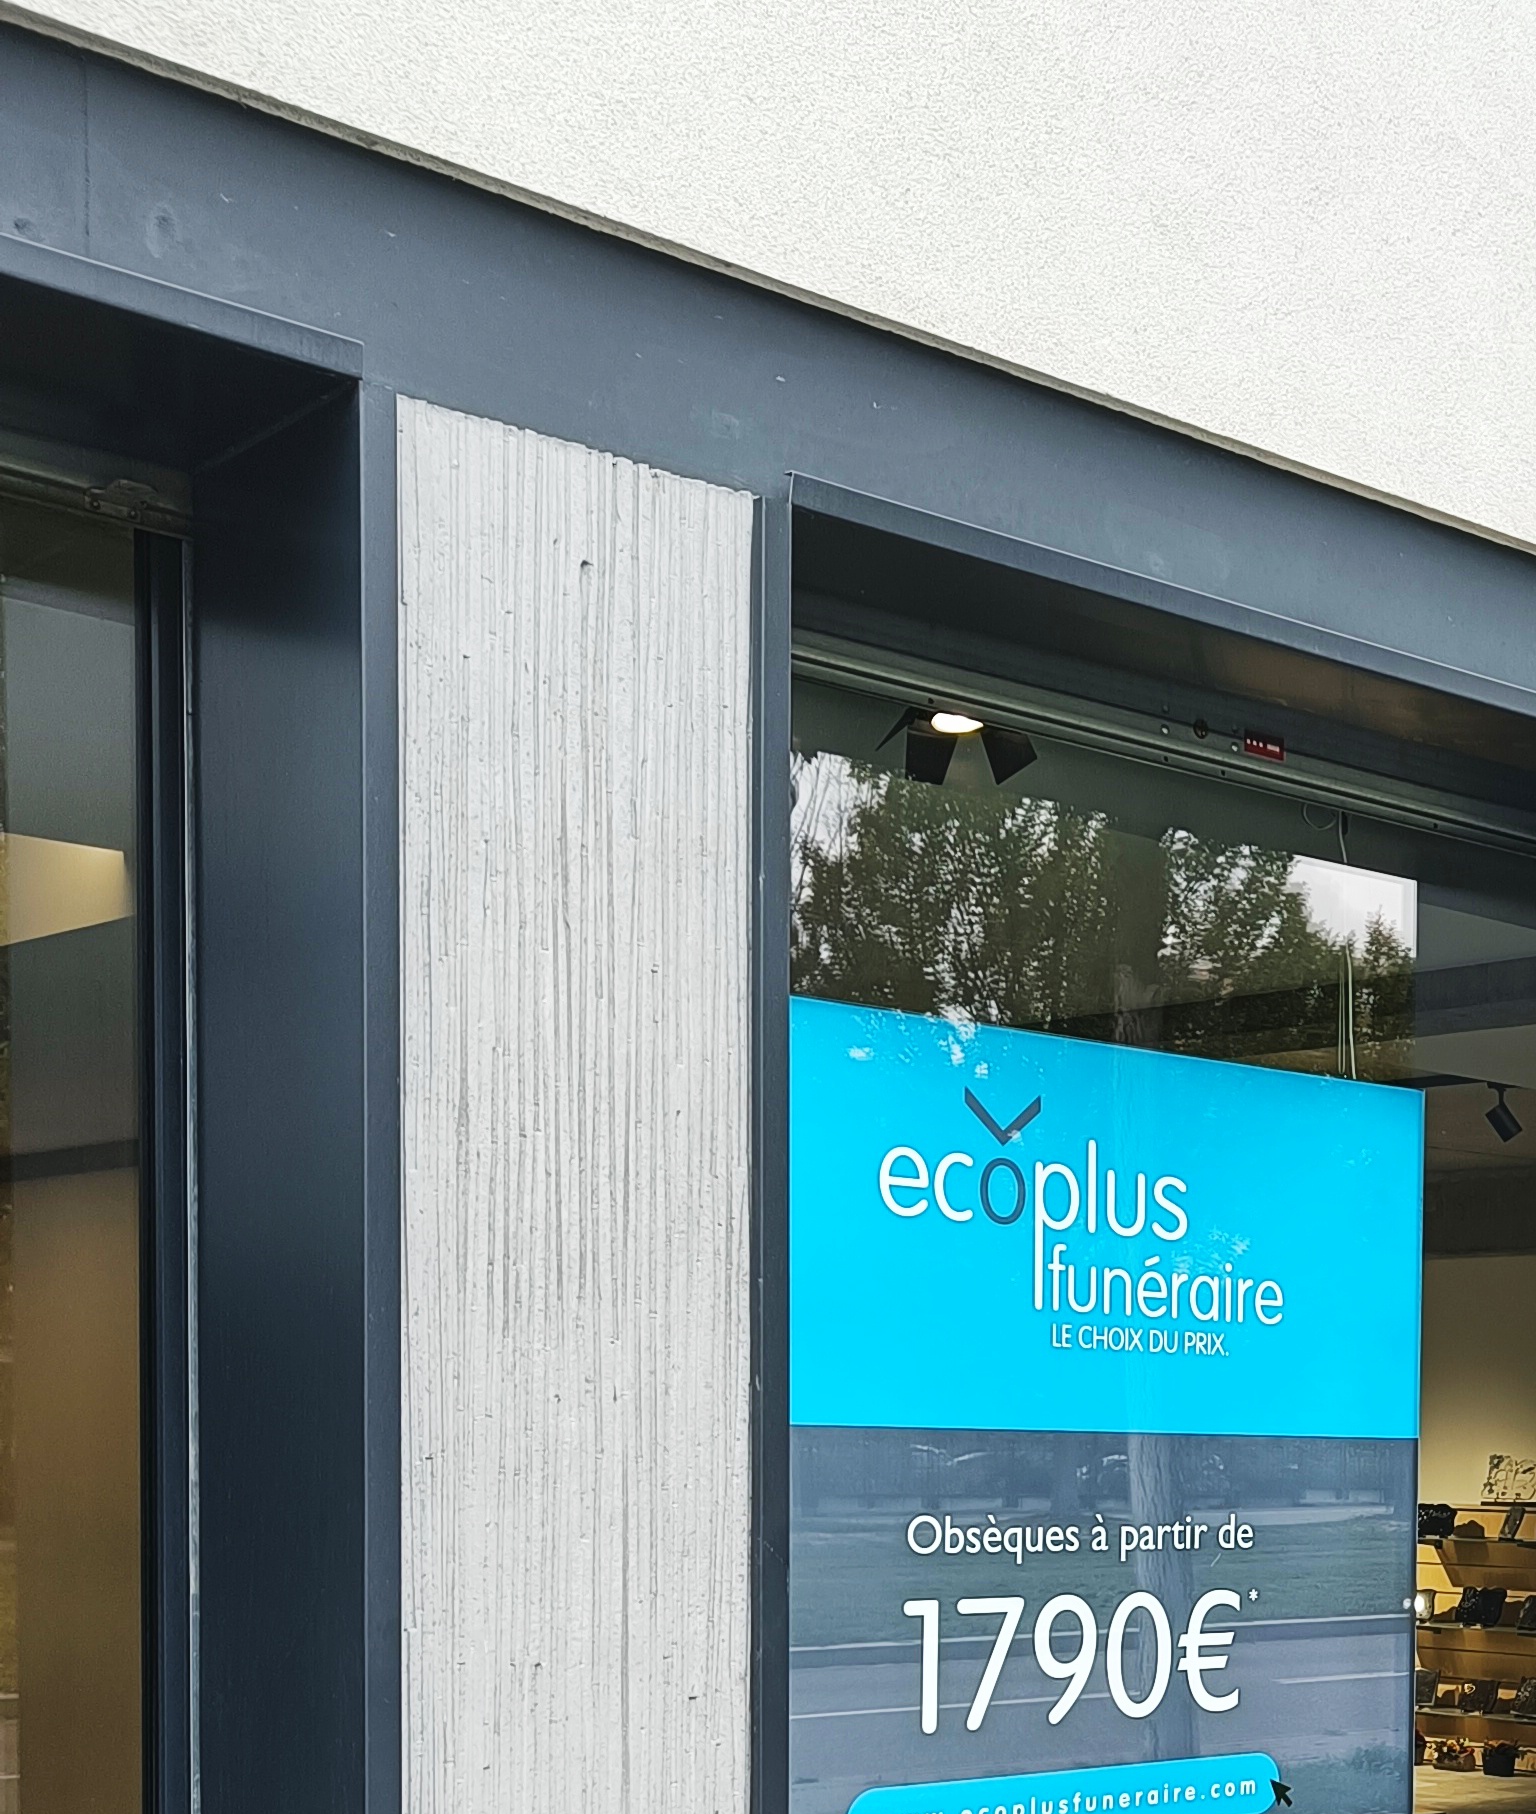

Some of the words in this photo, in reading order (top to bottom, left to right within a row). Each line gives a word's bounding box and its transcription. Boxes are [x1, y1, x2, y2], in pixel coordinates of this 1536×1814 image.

[878, 1139, 1189, 1311] ecoplus
[1047, 1243, 1285, 1325] funéraire
[1052, 1323, 1072, 1349] LE
[1078, 1325, 1144, 1353] CHOIX
[1149, 1329, 1179, 1354] DU
[907, 1514, 1081, 1566] Obsèques
[1091, 1513, 1110, 1552] à
[1120, 1516, 1208, 1562] partir
[1218, 1513, 1255, 1549] de
